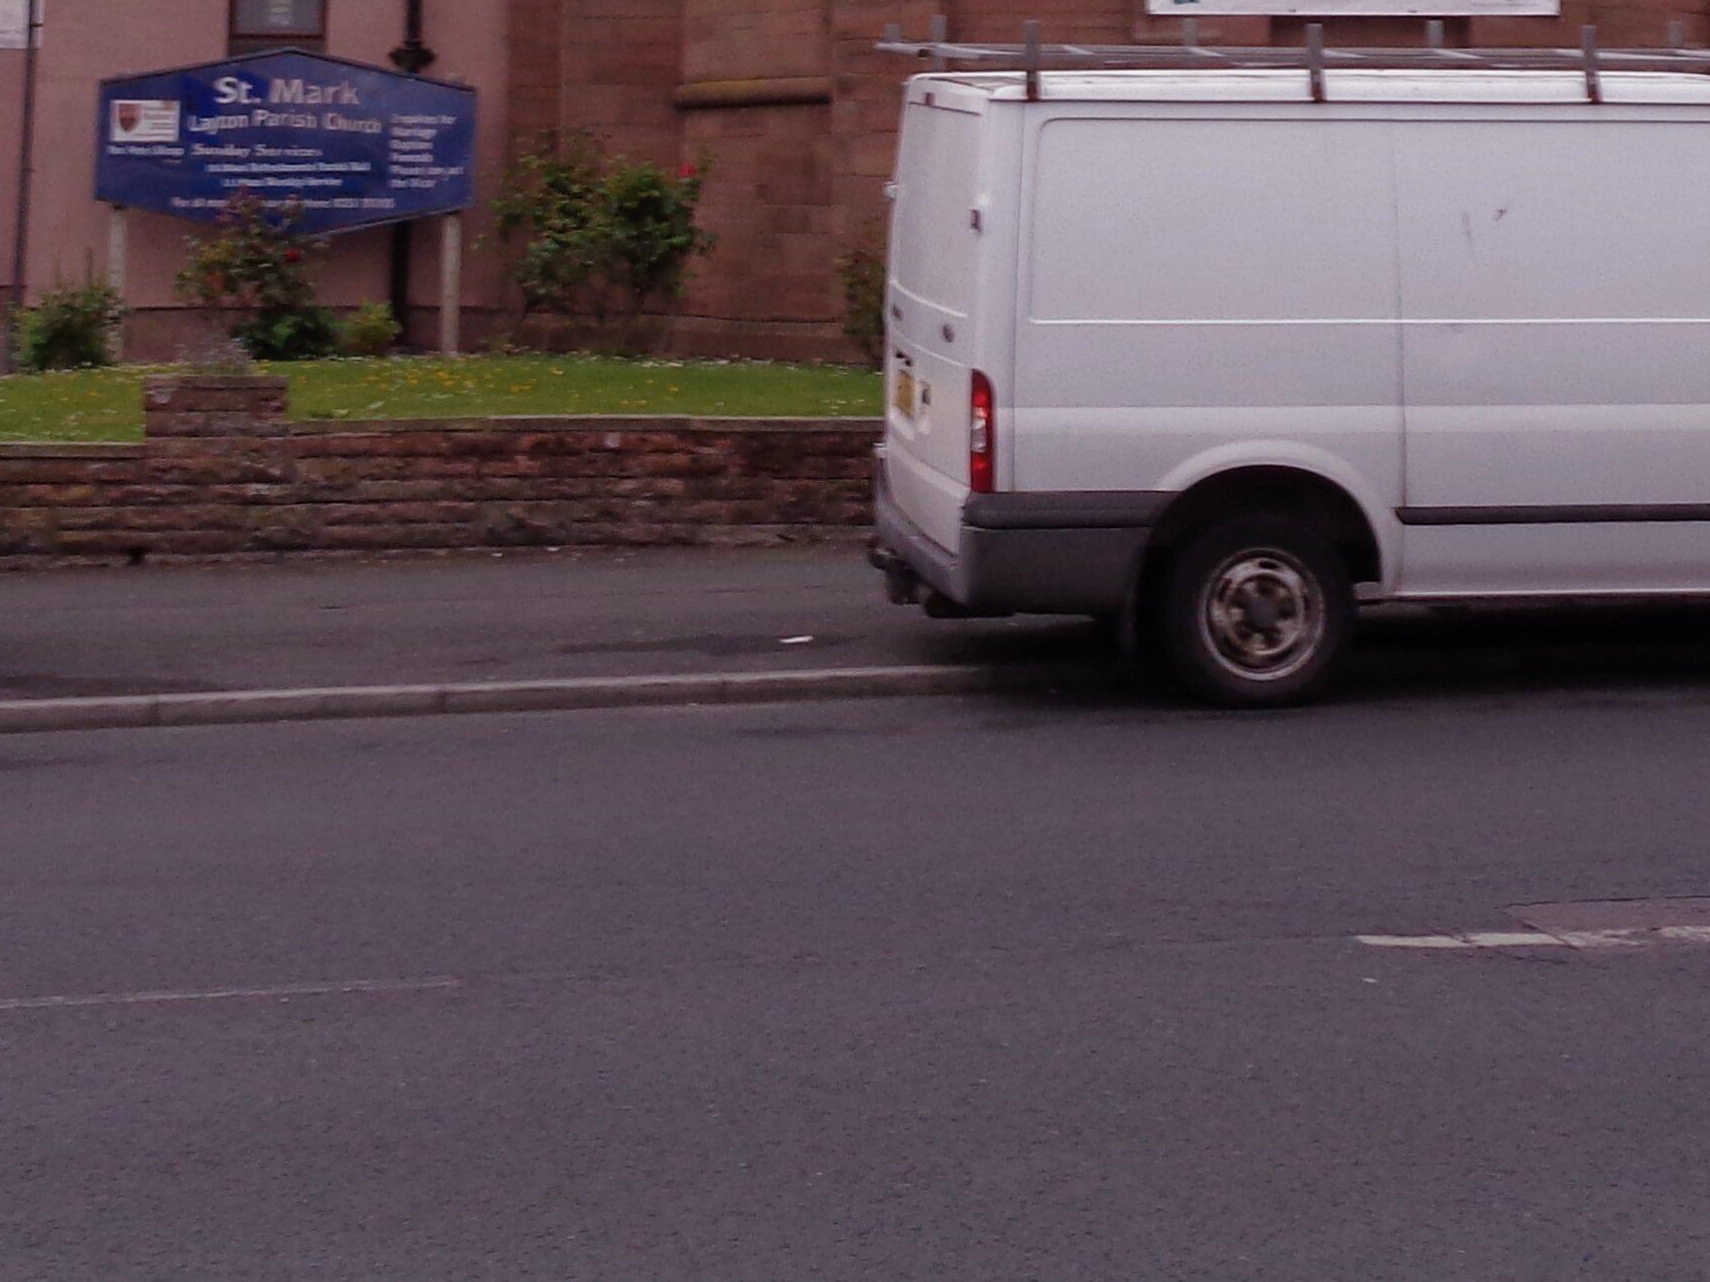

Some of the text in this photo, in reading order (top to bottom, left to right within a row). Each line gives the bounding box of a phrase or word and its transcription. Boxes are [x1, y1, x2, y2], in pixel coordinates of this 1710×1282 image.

[212, 76, 360, 105] St. Mark
[252, 109, 317, 129] Parish
[321, 112, 383, 134] Church
[191, 143, 251, 158] Sunday
